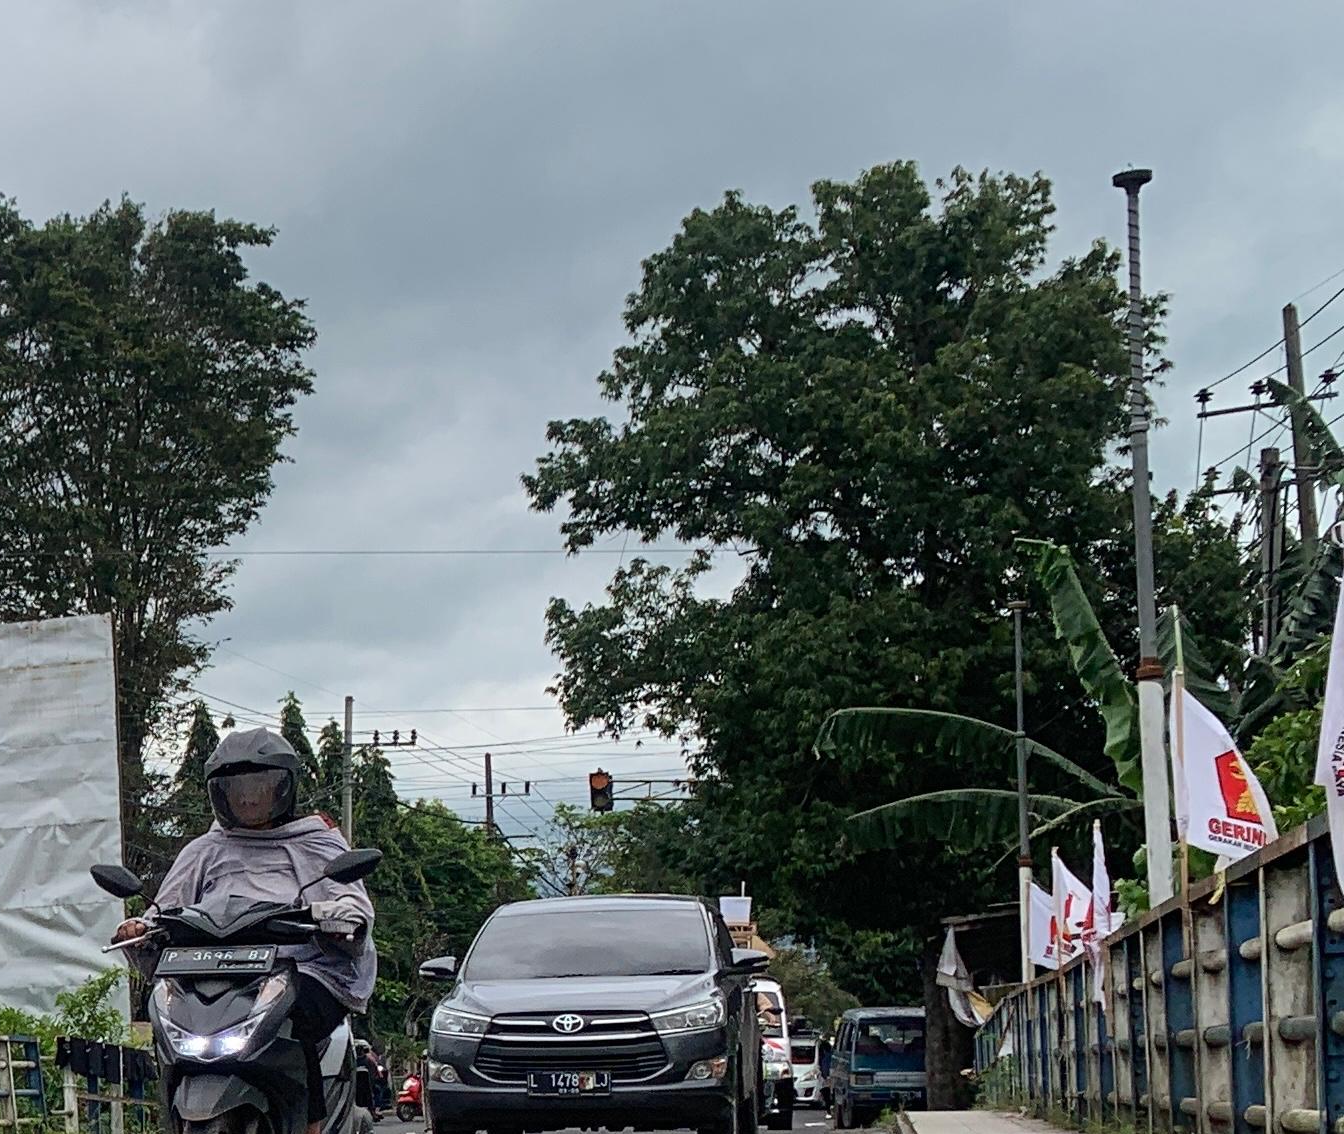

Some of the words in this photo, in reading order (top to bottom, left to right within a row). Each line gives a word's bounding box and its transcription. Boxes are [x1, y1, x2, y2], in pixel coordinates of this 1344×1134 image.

[167, 951, 178, 962] P
[247, 950, 270, 961] BJ
[530, 1073, 538, 1088] L
[550, 1073, 580, 1088] 1478
[593, 1073, 608, 1088] LJ
